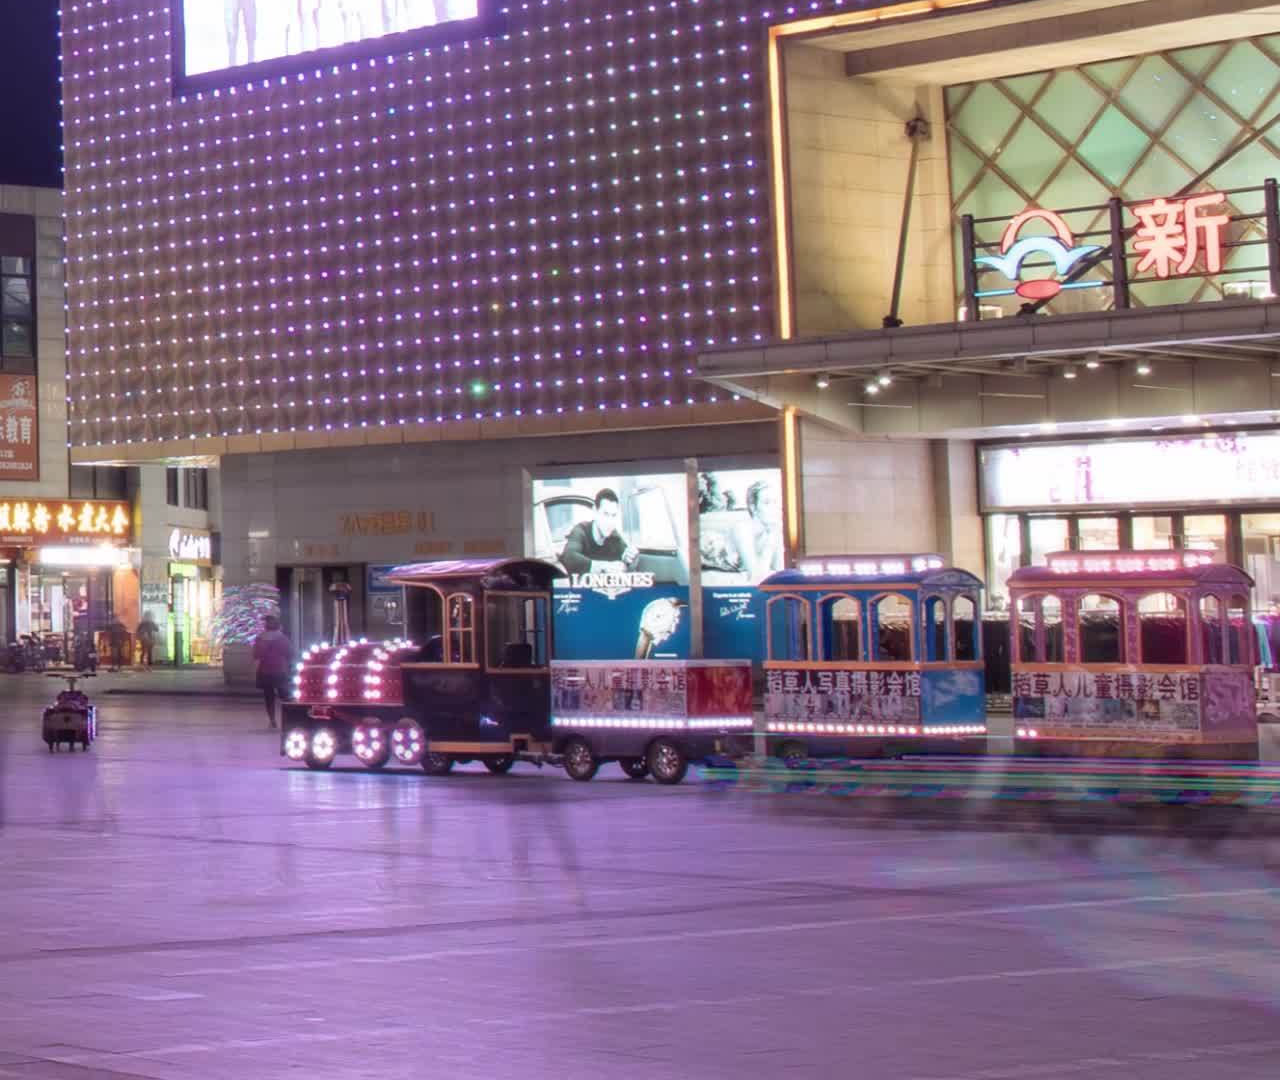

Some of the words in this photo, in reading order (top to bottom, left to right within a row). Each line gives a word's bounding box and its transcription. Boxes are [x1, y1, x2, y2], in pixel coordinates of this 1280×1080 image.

[1133, 192, 1229, 279] 新
[571, 572, 655, 589] LONGINES
[766, 669, 922, 698] 稻草人写真摄影会馆
[1013, 672, 1200, 702] 稻草人儿童摄影会馆
